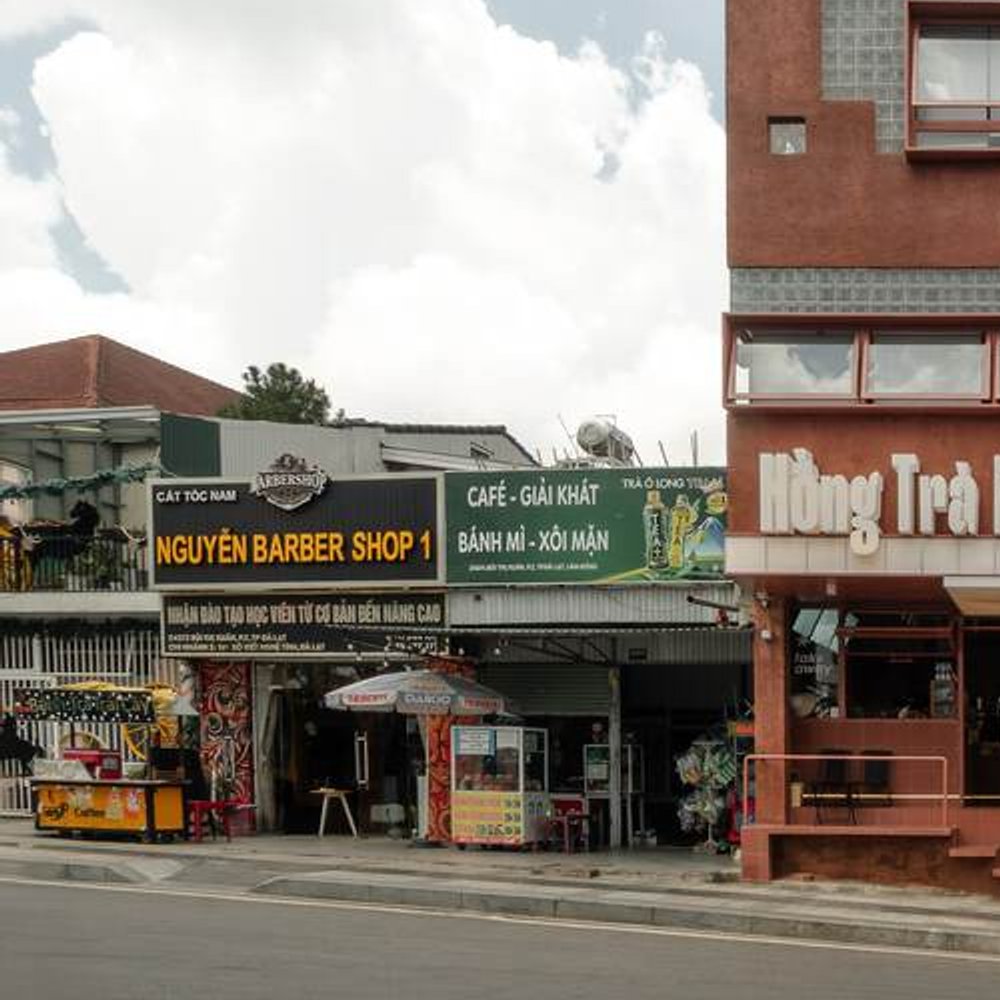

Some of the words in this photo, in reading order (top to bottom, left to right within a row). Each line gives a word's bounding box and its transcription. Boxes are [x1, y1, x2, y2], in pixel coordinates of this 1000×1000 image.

[210, 490, 237, 501] NAM
[467, 480, 507, 507] CAFÉ
[520, 478, 552, 506] GIẢI
[557, 478, 600, 506] KHÁT
[891, 453, 979, 535] Trà
[156, 528, 247, 565] NGUYỄN
[253, 532, 344, 563] BARBER
[352, 530, 413, 561] SHOP
[420, 529, 431, 560] 1
[458, 525, 502, 553] BÁNH
[506, 525, 525, 552] MÌ
[538, 525, 568, 552] XÔI
[571, 524, 609, 557] MẶN
[417, 603, 441, 624] CAO
